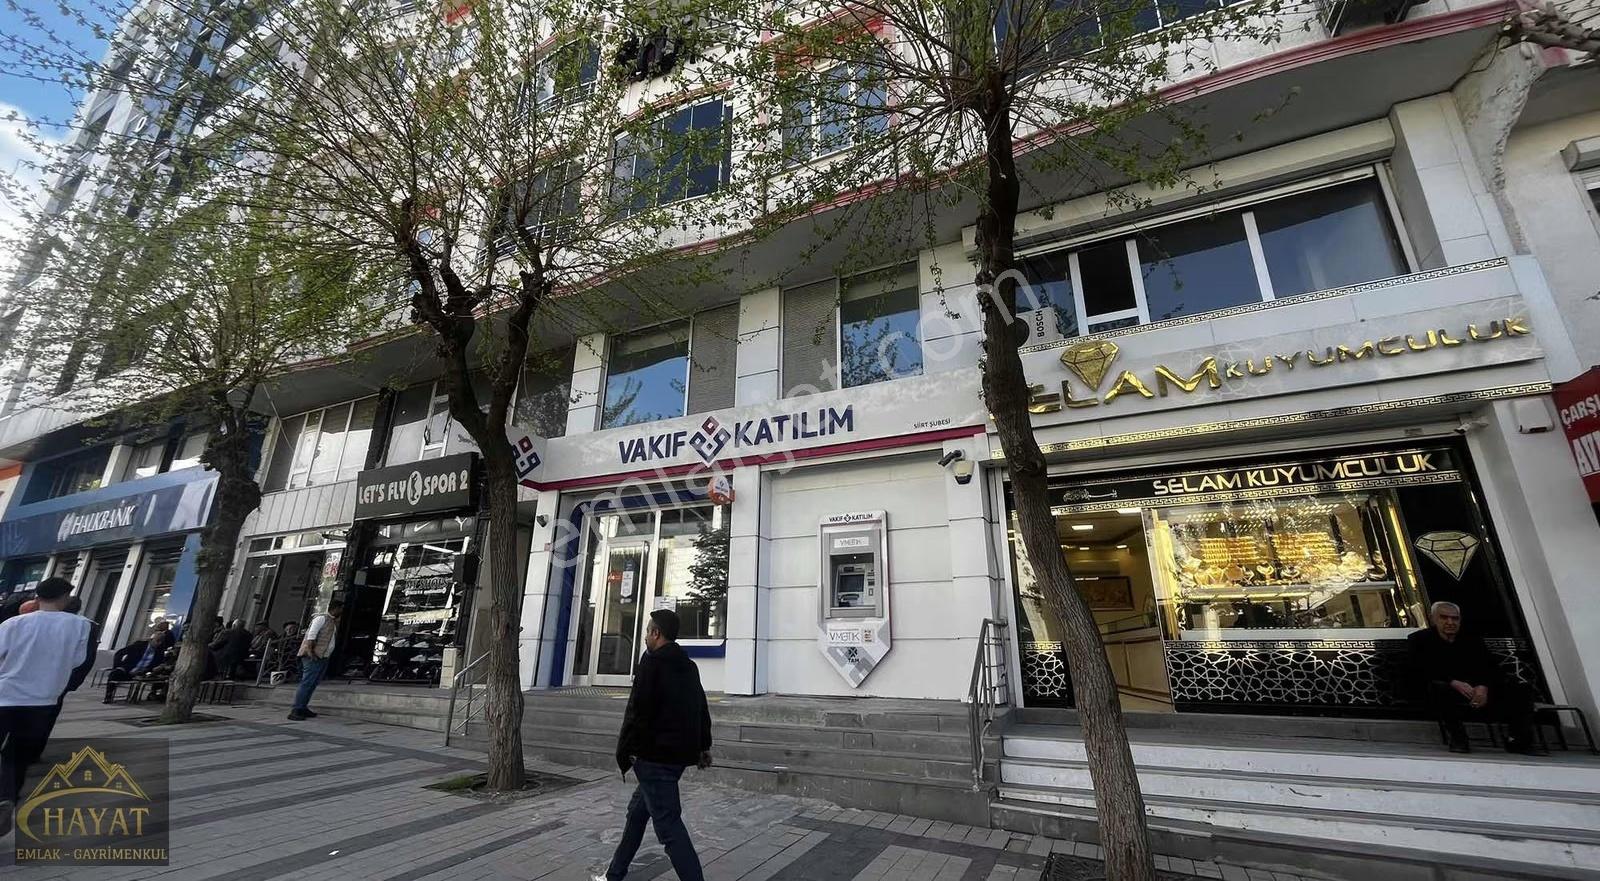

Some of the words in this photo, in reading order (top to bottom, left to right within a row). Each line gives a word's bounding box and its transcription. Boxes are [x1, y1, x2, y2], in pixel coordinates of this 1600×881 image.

[1035, 310, 1045, 338] BOSCH
[990, 357, 1221, 418] ELAM
[1224, 316, 1530, 379] KUYUMCULUK
[618, 431, 687, 464] VAKIF
[734, 404, 853, 448] KATILIM
[359, 484, 385, 504] LET'S
[388, 480, 407, 501] FLY
[423, 472, 457, 496] SPOR
[459, 469, 468, 490] 2
[1152, 472, 1242, 496] SELAM
[1246, 453, 1437, 487] KUYUMCULUK
[70, 504, 135, 535] HALKBANK
[852, 513, 873, 521] KATILIM
